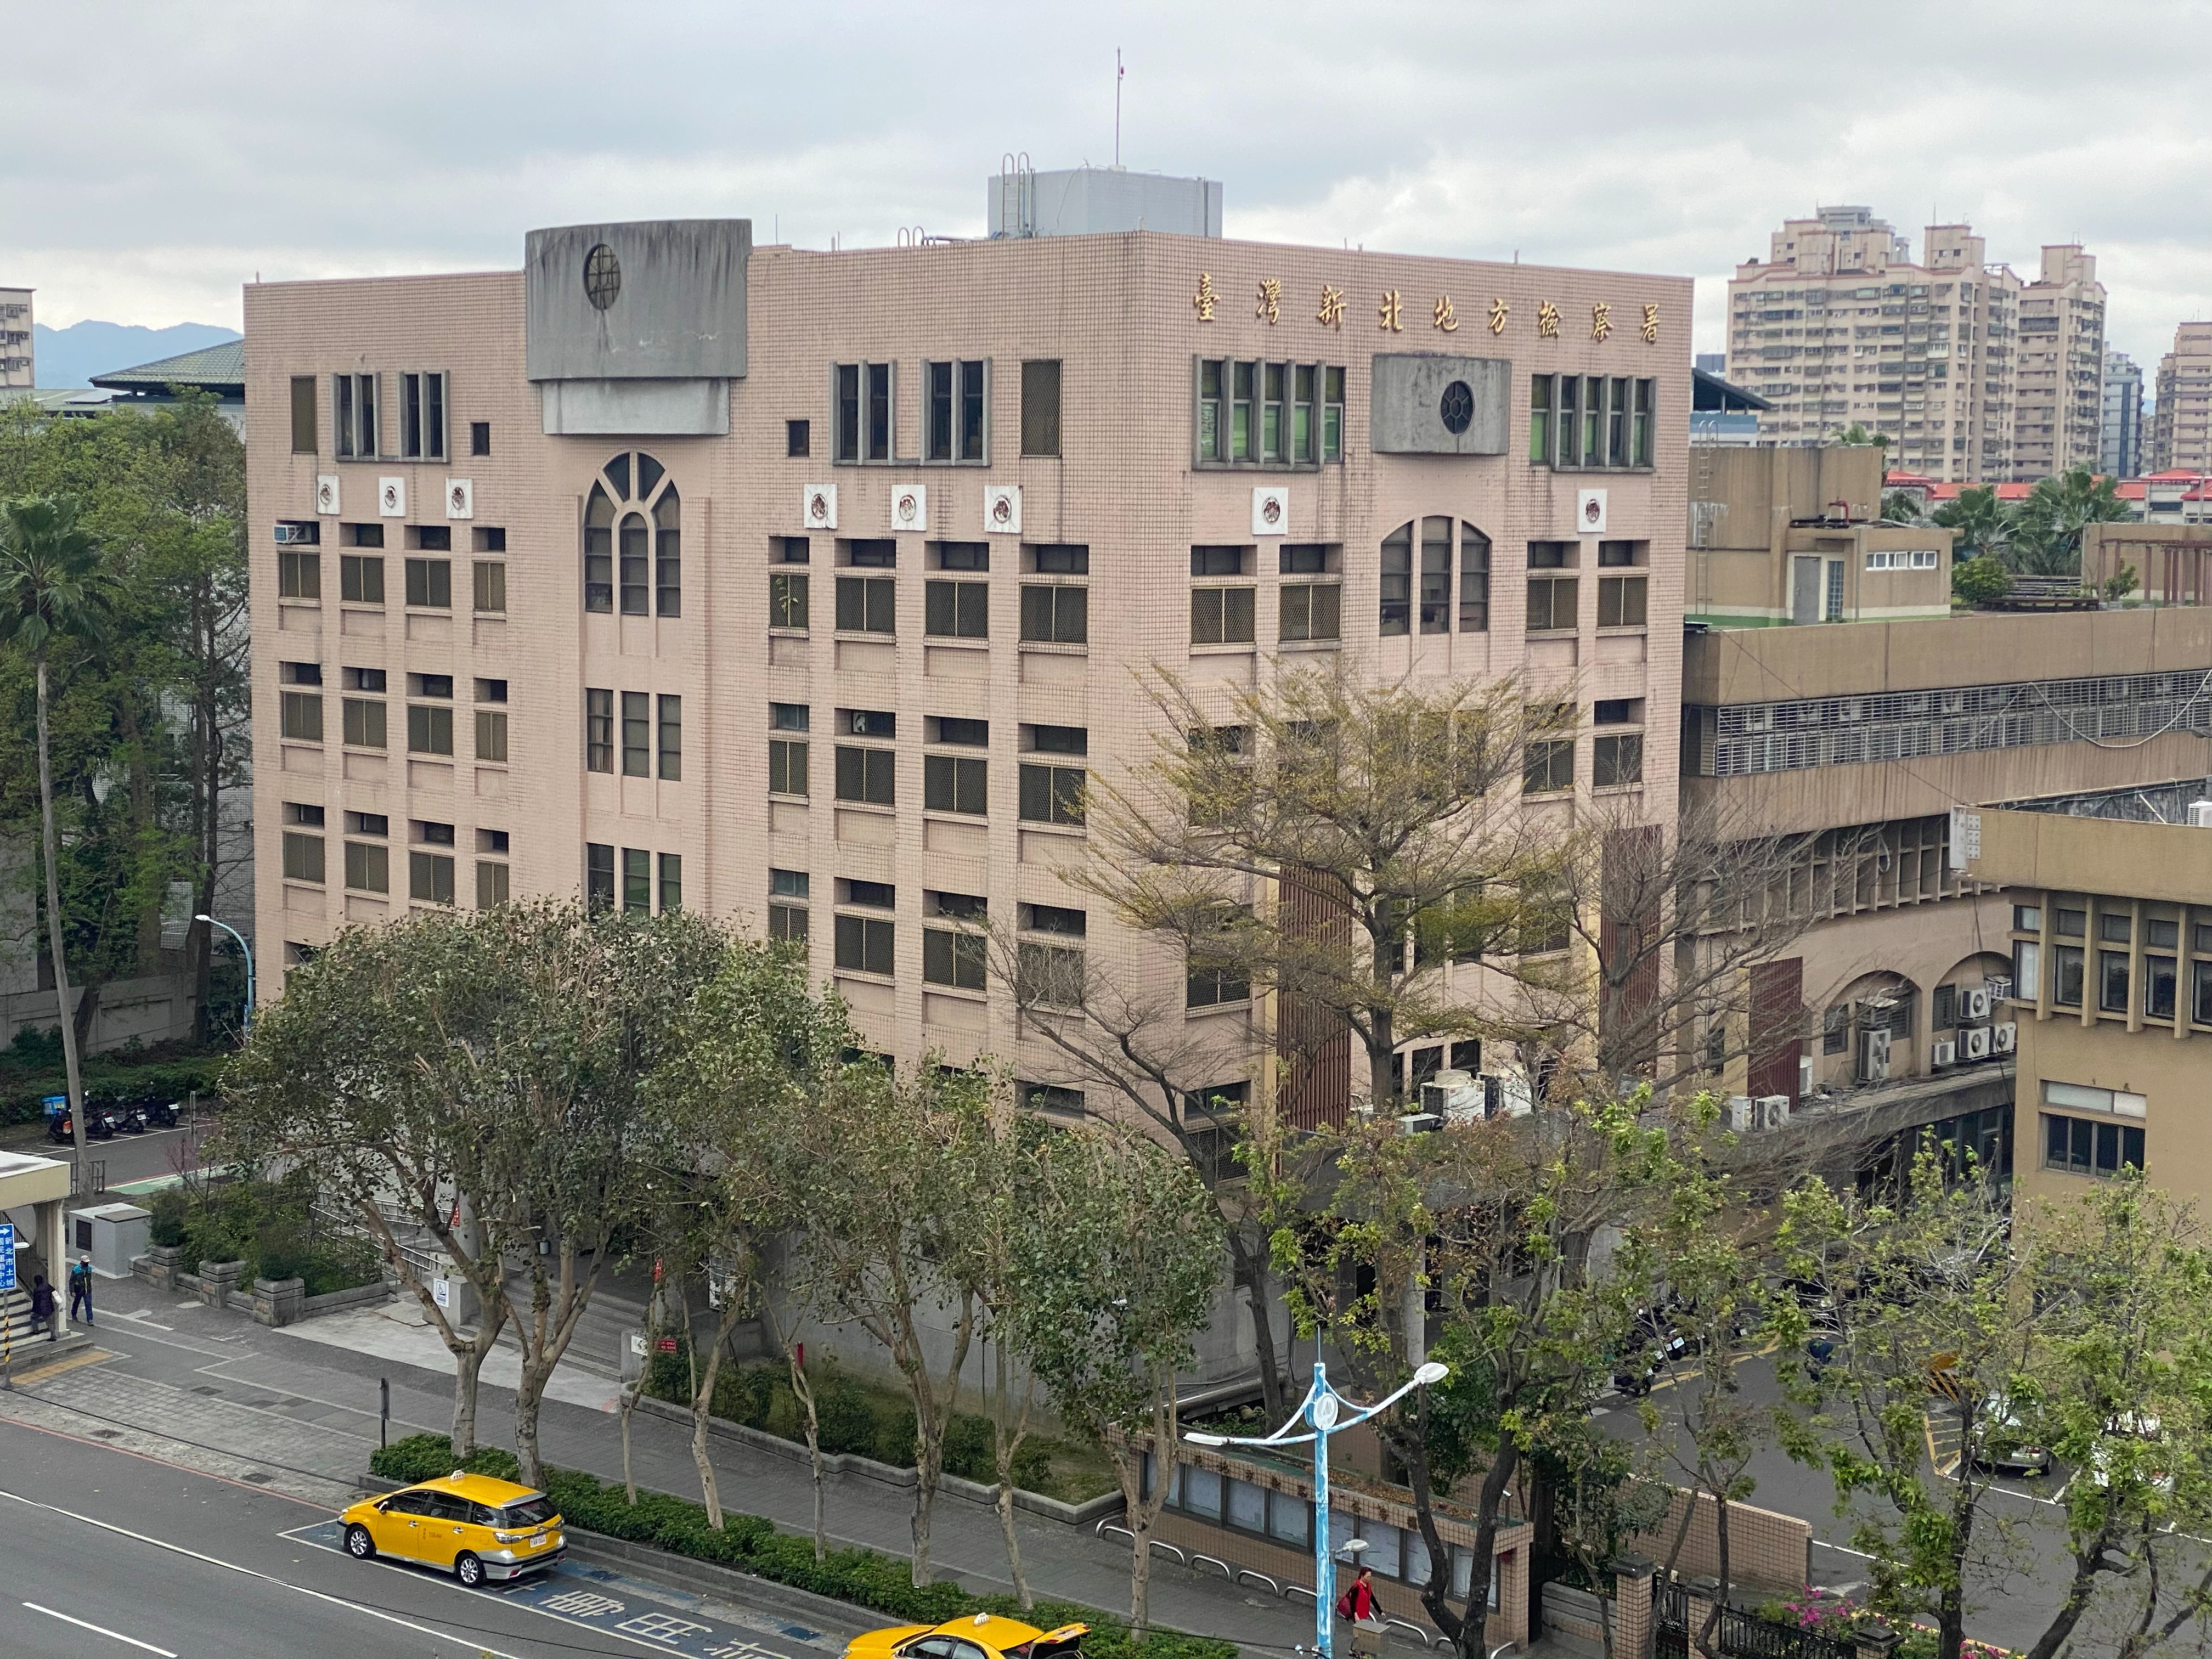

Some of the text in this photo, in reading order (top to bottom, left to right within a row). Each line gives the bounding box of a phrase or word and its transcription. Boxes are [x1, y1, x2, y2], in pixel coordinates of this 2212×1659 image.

[1194, 273, 1661, 341] 臺灣新北地方檢察署
[5, 1237, 14, 1286] 新北市土城
